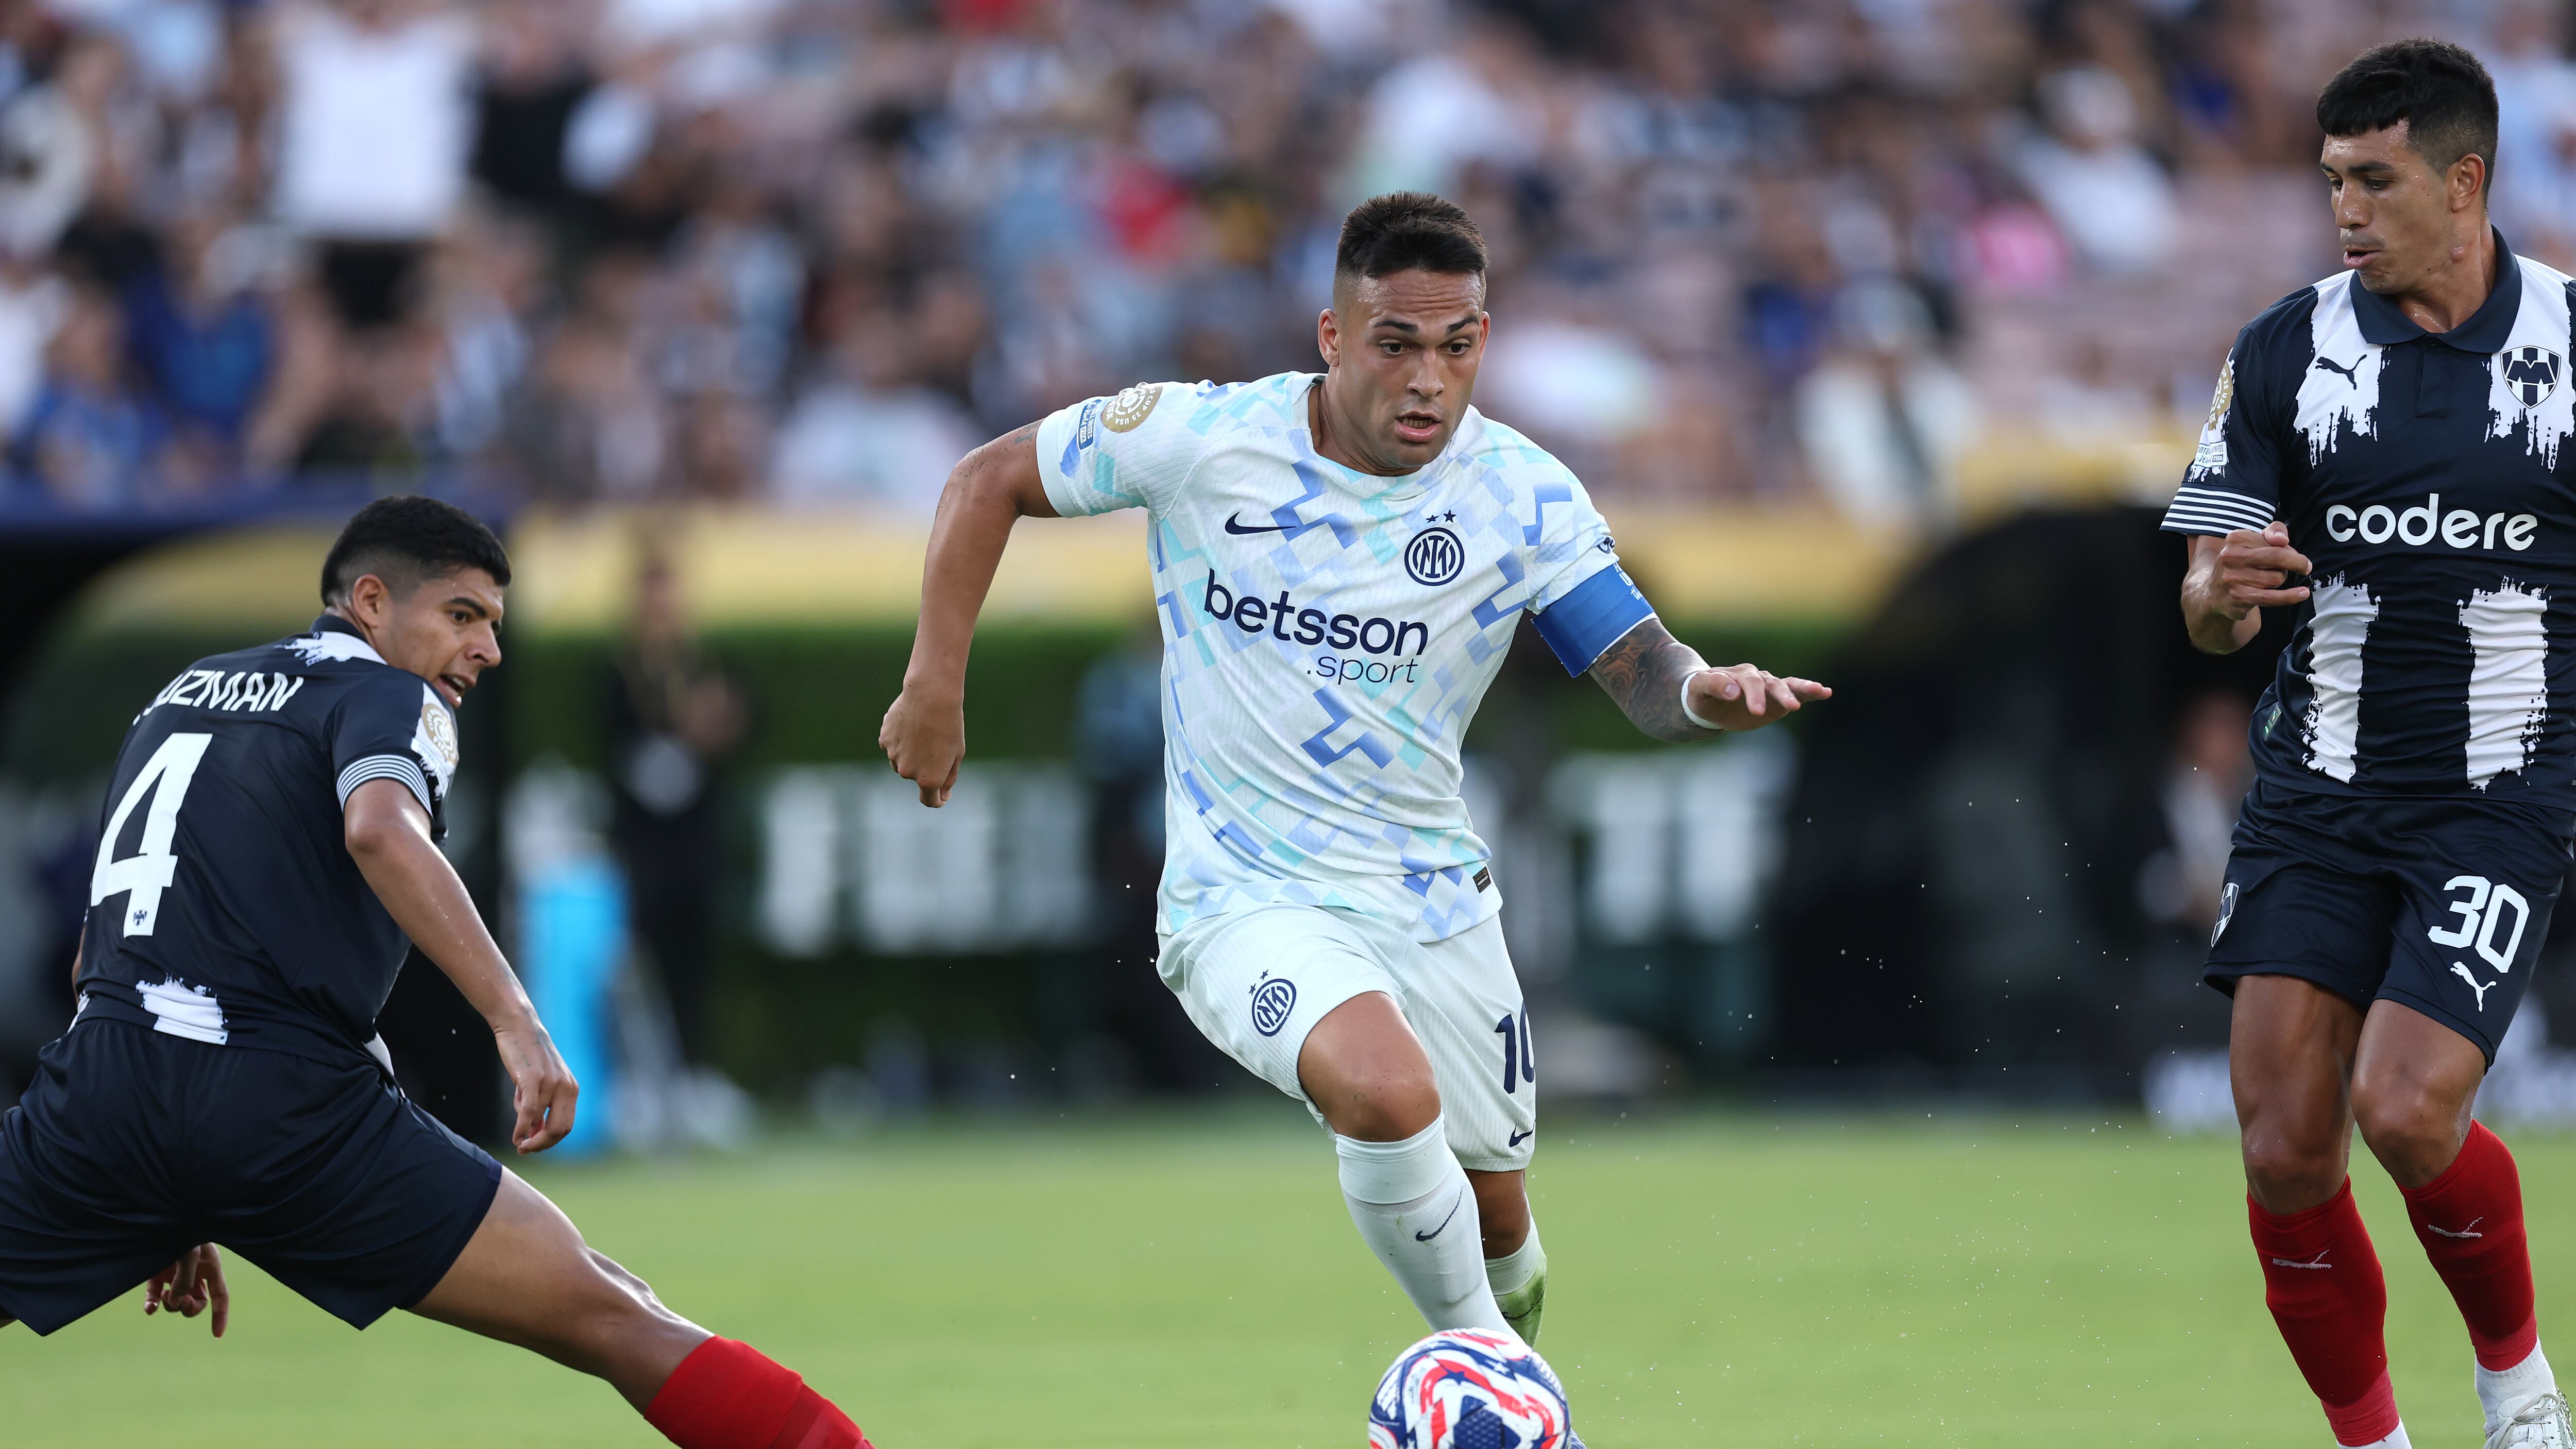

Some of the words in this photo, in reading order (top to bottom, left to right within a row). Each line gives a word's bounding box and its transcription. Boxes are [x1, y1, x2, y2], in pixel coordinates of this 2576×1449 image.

[2224, 379, 2228, 389] 25
[1106, 401, 1115, 420] FIFA
[1142, 396, 1154, 411] CUP
[2217, 393, 2228, 409] USA
[1132, 411, 1141, 421] 25
[1087, 416, 1095, 439] UNITES
[2211, 445, 2224, 453] UNITES
[2326, 493, 2538, 551] codere
[1204, 567, 1428, 656] betsson
[1307, 656, 1418, 685] .sport
[90, 732, 213, 938] 4
[2427, 875, 2530, 973] 30
